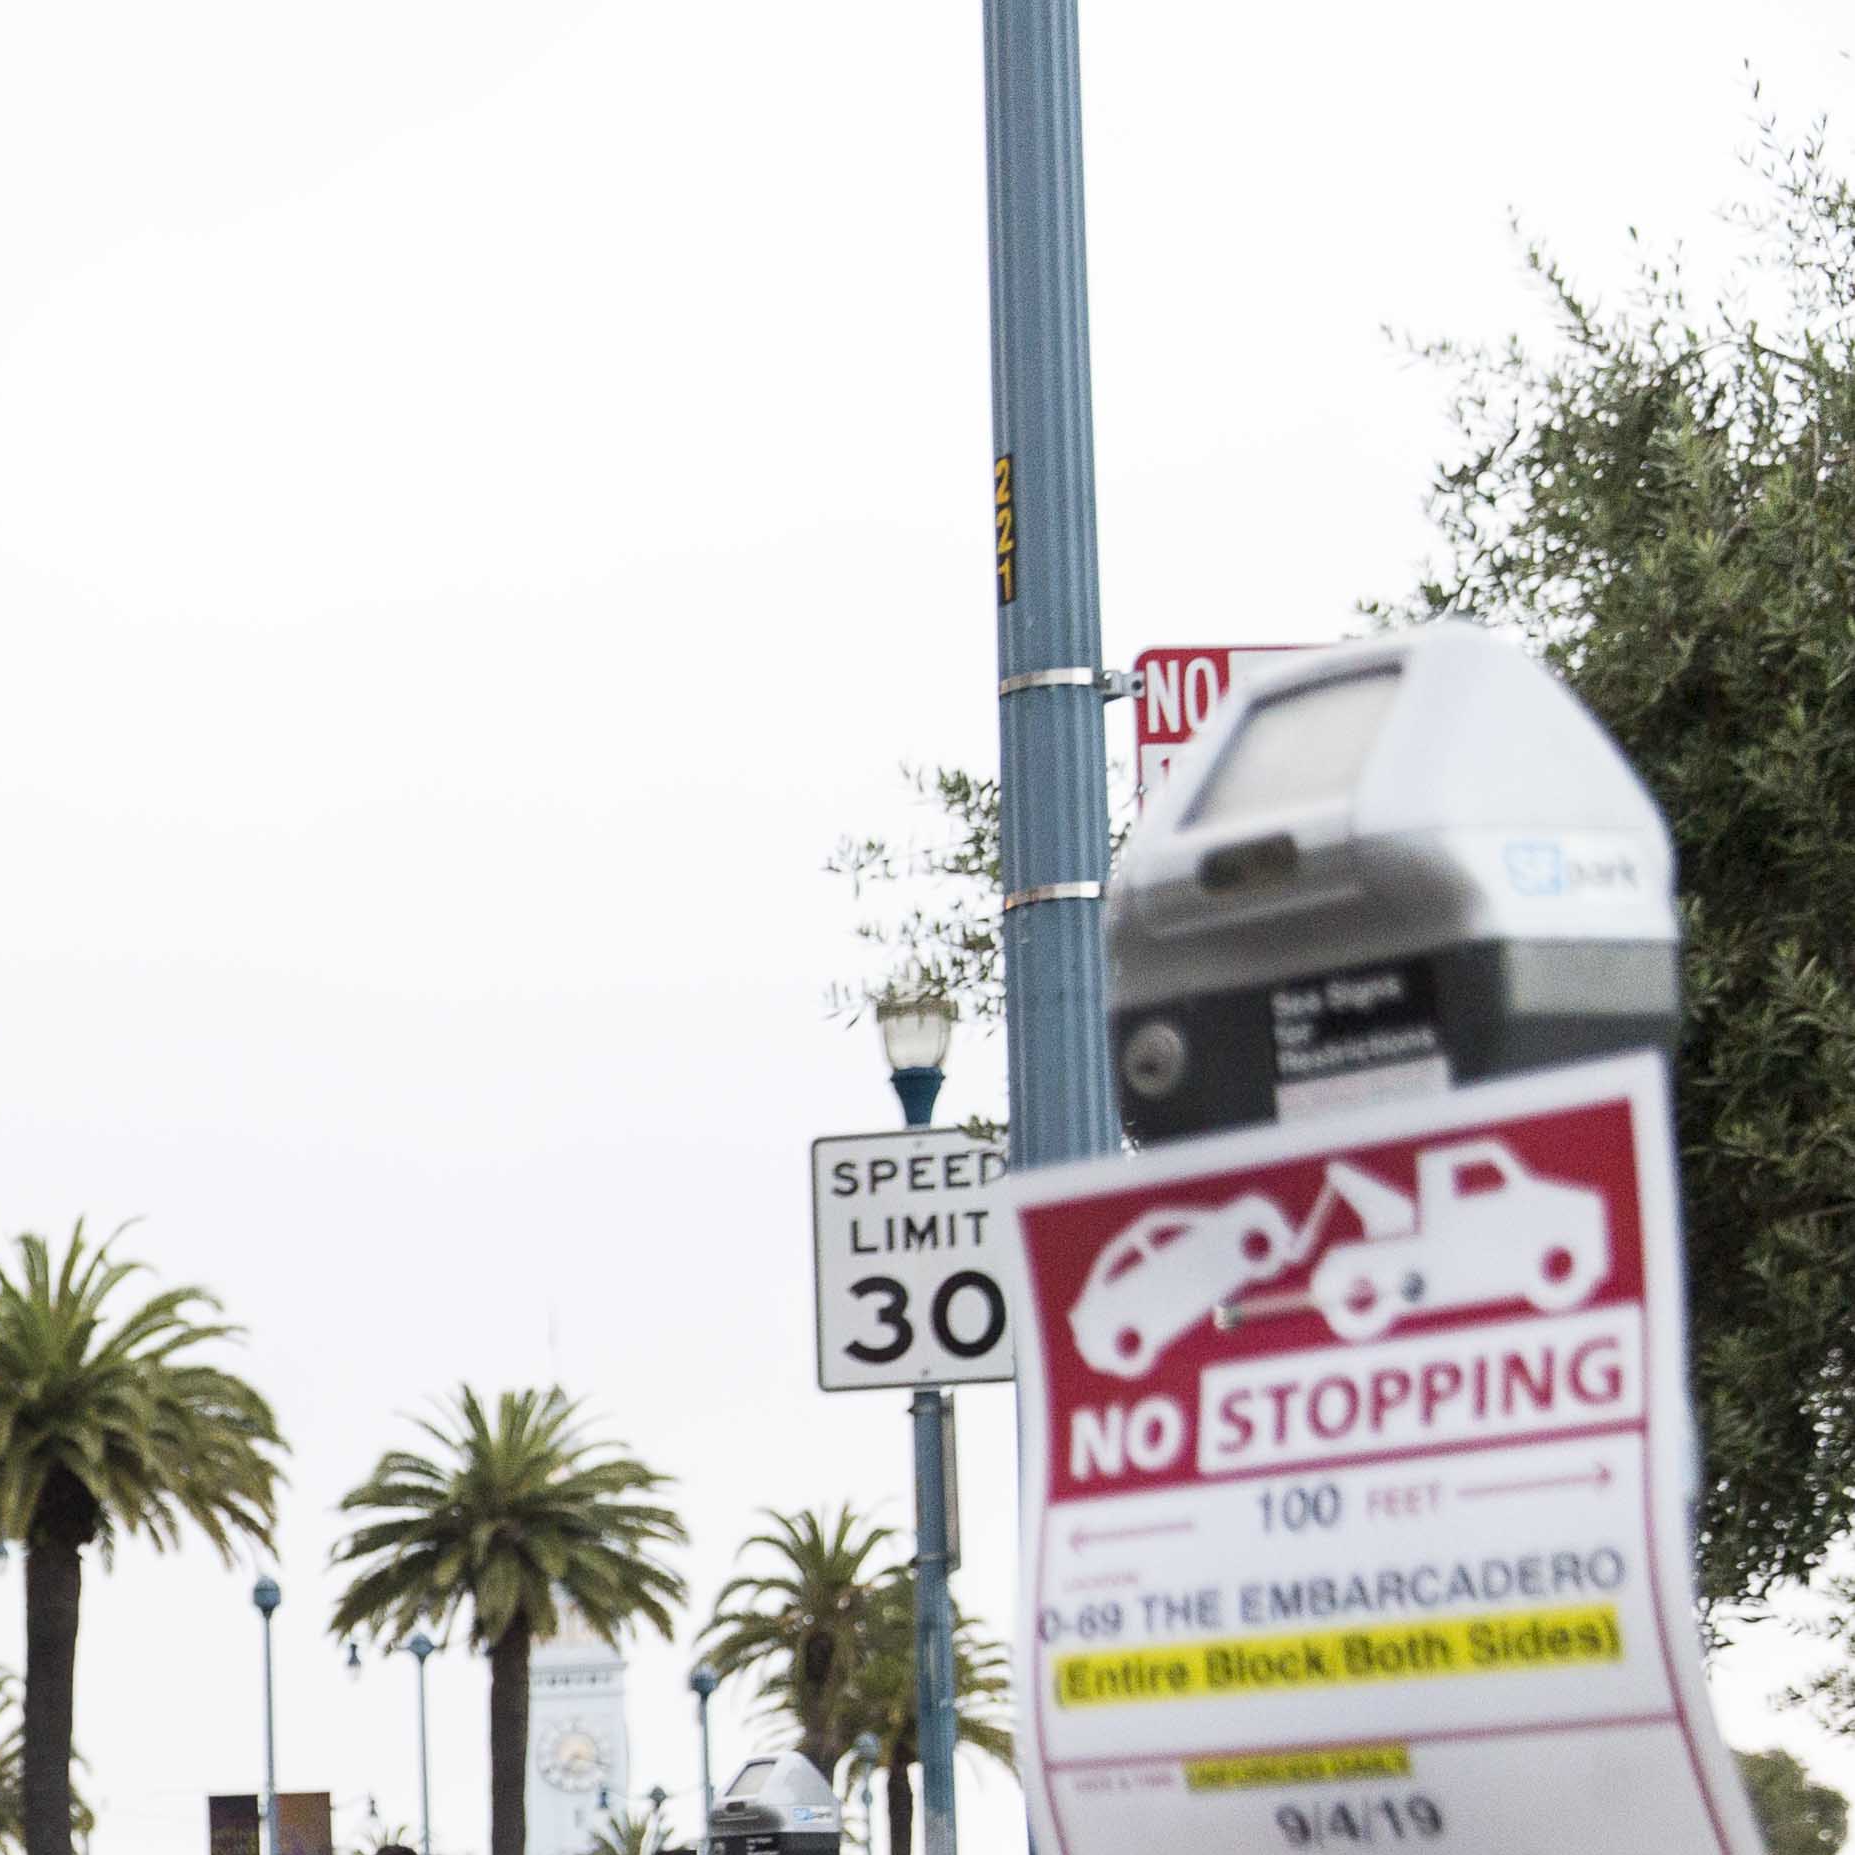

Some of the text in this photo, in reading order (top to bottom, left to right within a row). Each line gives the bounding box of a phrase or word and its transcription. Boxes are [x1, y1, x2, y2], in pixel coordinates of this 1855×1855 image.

[1146, 656, 1221, 734] NO
[832, 1151, 1008, 1197] SPEED
[849, 1210, 989, 1254] LIMIT
[844, 1269, 1007, 1365] 30
[1069, 1336, 1624, 1482] NO STOPPING
[1257, 1481, 1444, 1533] 100 FEET
[1140, 1593, 1224, 1632] THE
[1241, 1546, 1628, 1626] EMBARCADERO
[1204, 1640, 1326, 1686] Block
[1343, 1631, 1451, 1675] Both
[1275, 1796, 1444, 1850] 9/4/19
